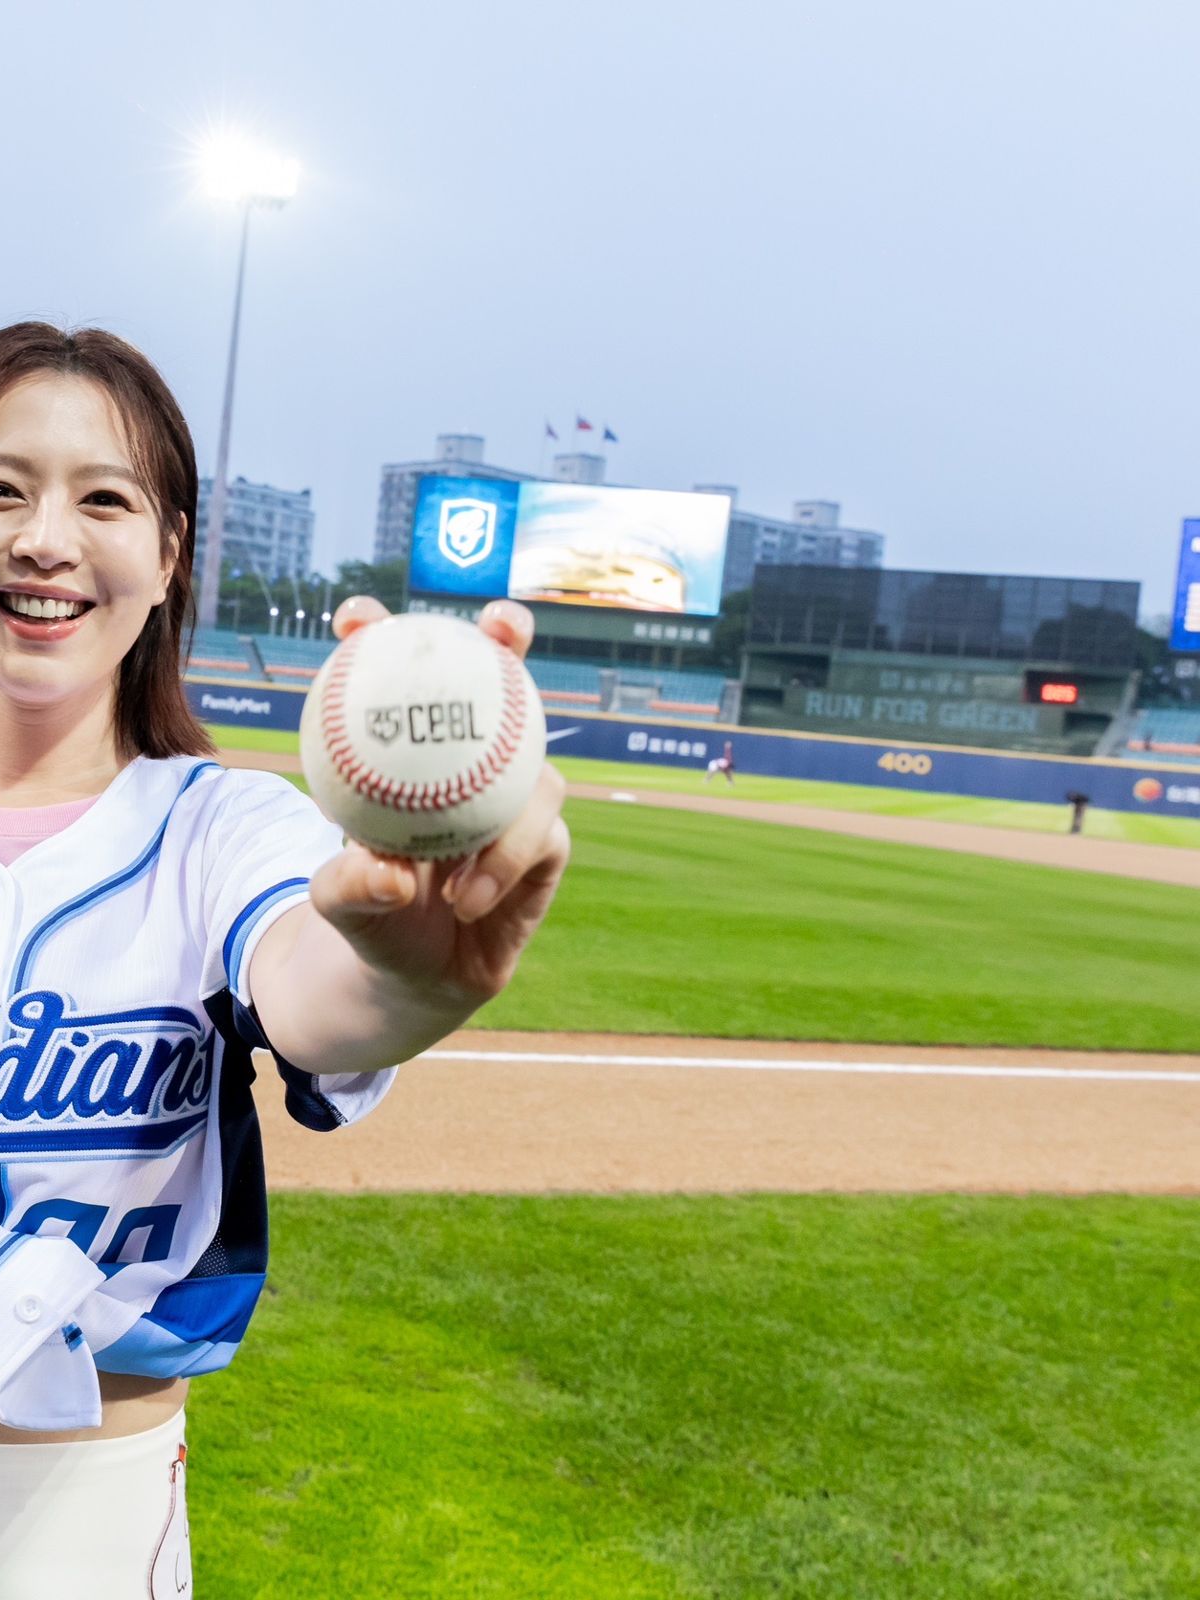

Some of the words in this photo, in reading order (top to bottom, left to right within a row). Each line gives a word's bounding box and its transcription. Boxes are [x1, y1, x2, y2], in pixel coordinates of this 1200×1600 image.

[201, 694, 271, 714] FamilyMart
[804, 690, 863, 719] RUN
[872, 696, 927, 724] FOR
[877, 752, 932, 775] 400
